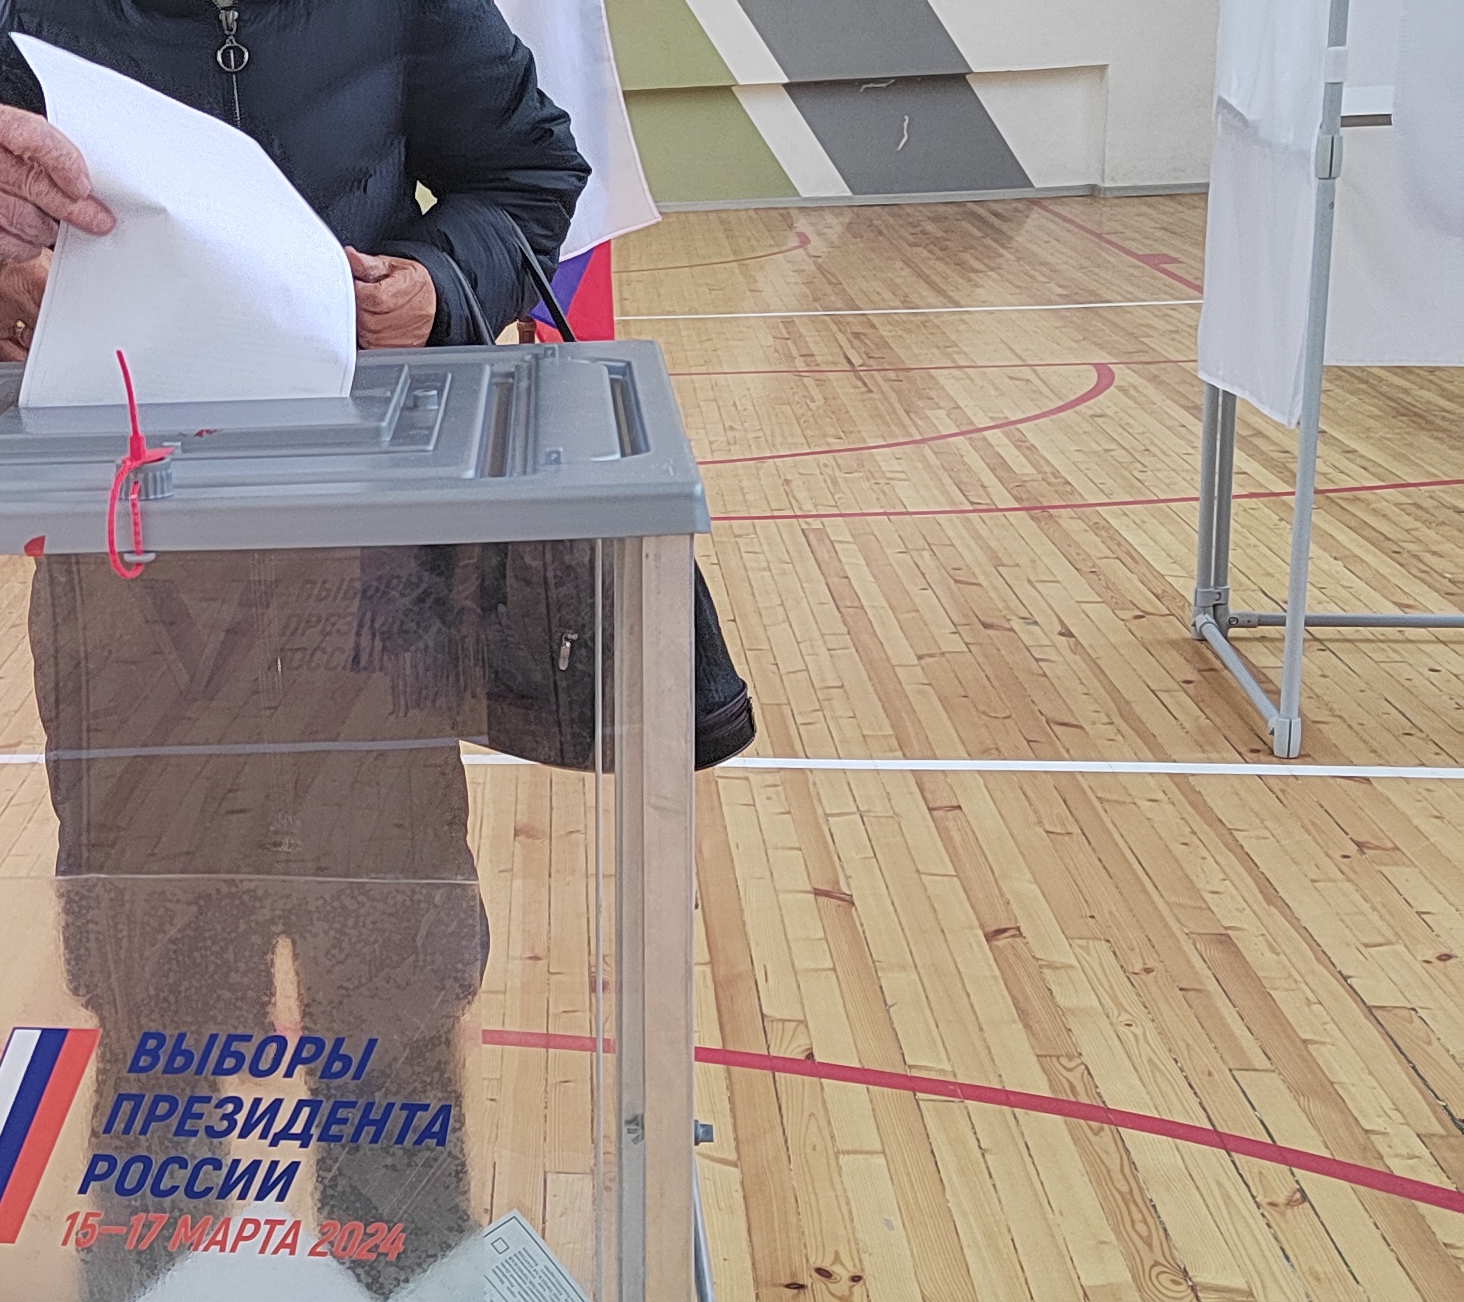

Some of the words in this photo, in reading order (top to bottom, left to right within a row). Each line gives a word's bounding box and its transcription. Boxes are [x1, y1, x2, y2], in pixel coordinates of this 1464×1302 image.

[127, 1030, 379, 1081] ВЫБОРЫ
[102, 1093, 453, 1149] ПРЕЗИДЕНТА
[77, 1153, 302, 1203] РОССИИ
[168, 1215, 304, 1257] МАРТА
[307, 1219, 407, 1262] 2024
